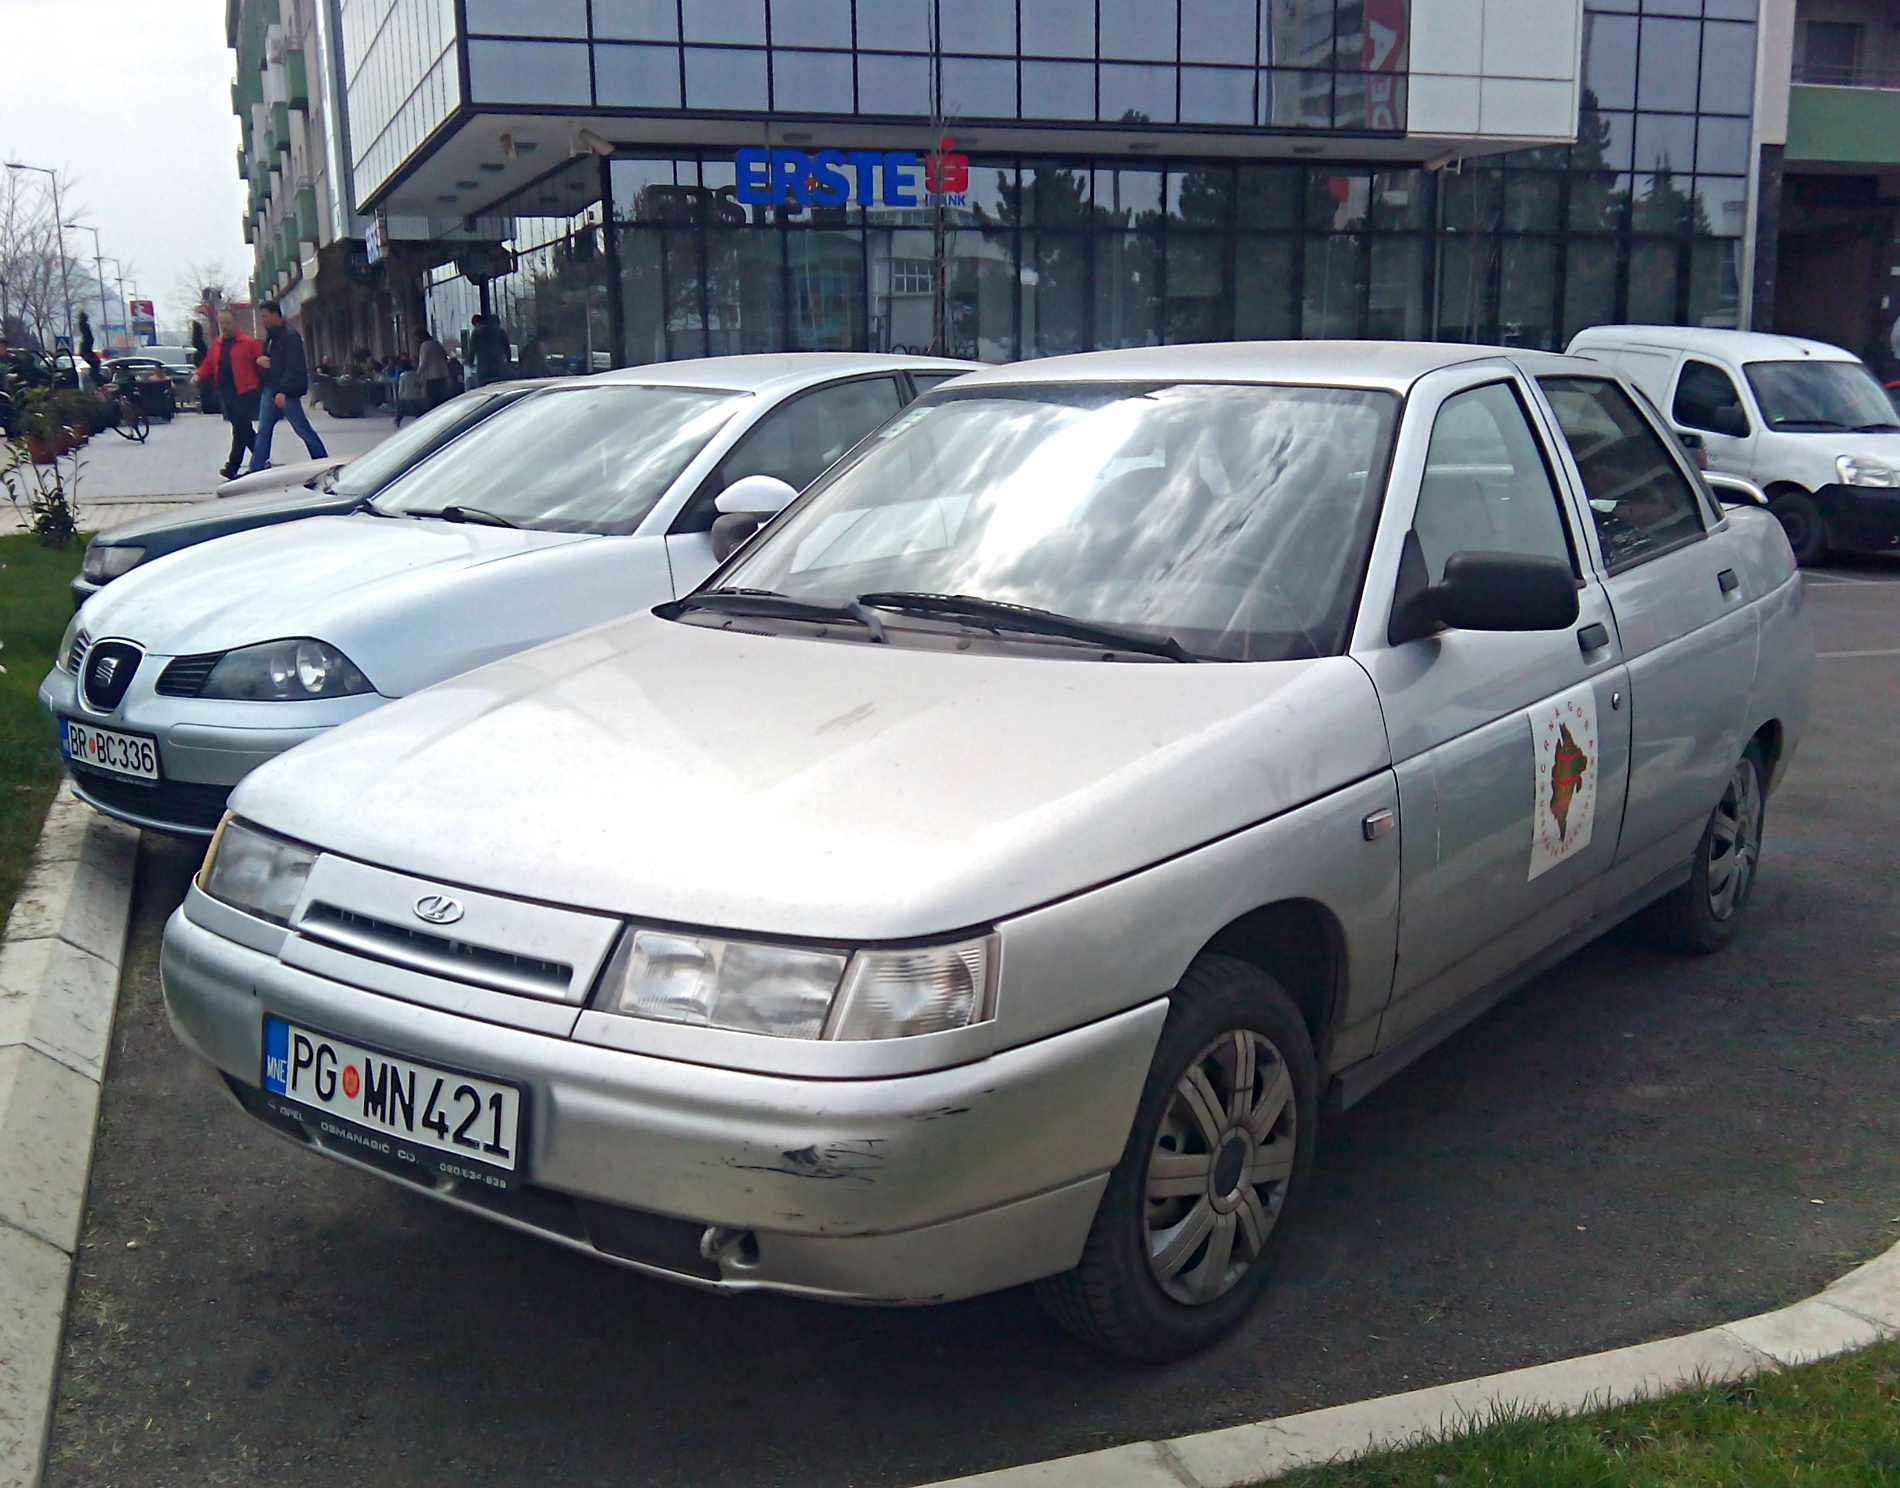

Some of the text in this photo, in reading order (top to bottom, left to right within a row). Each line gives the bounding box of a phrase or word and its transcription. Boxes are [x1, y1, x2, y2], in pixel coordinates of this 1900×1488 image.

[736, 149, 917, 206] ERSTE
[69, 725, 154, 773] BR BC336
[267, 1055, 287, 1084] MNE
[292, 1033, 509, 1159] PG MN421
